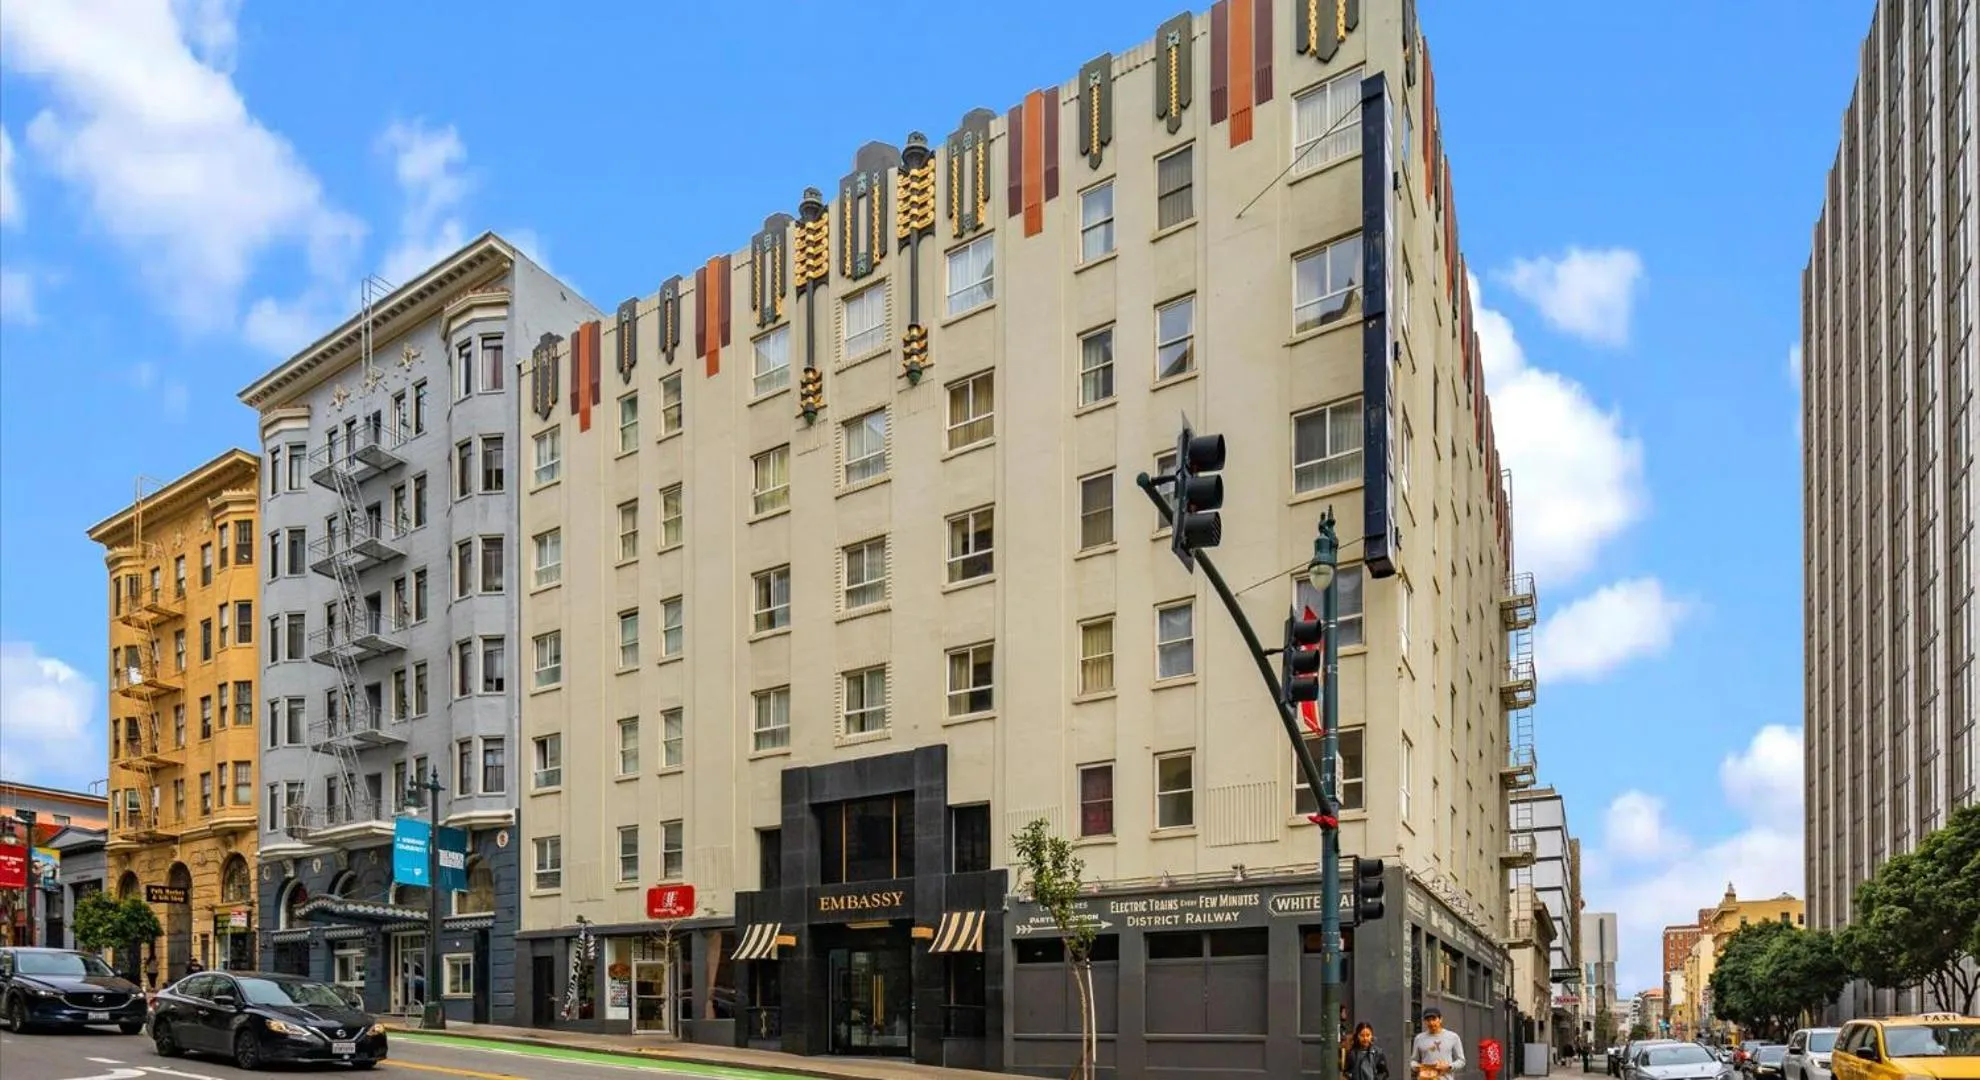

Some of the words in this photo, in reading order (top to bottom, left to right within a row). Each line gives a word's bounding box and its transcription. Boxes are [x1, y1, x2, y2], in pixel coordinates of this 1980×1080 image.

[819, 890, 904, 911] EMBASSY
[1110, 901, 1147, 913] ELECTRIC
[1149, 898, 1179, 911] TRAINS
[1199, 895, 1217, 908] FEW
[1219, 893, 1259, 907] MINUTES
[1127, 914, 1180, 927] DISTRICT
[1185, 911, 1240, 924] RAILWAY
[1923, 1014, 1957, 1022] TAXI
